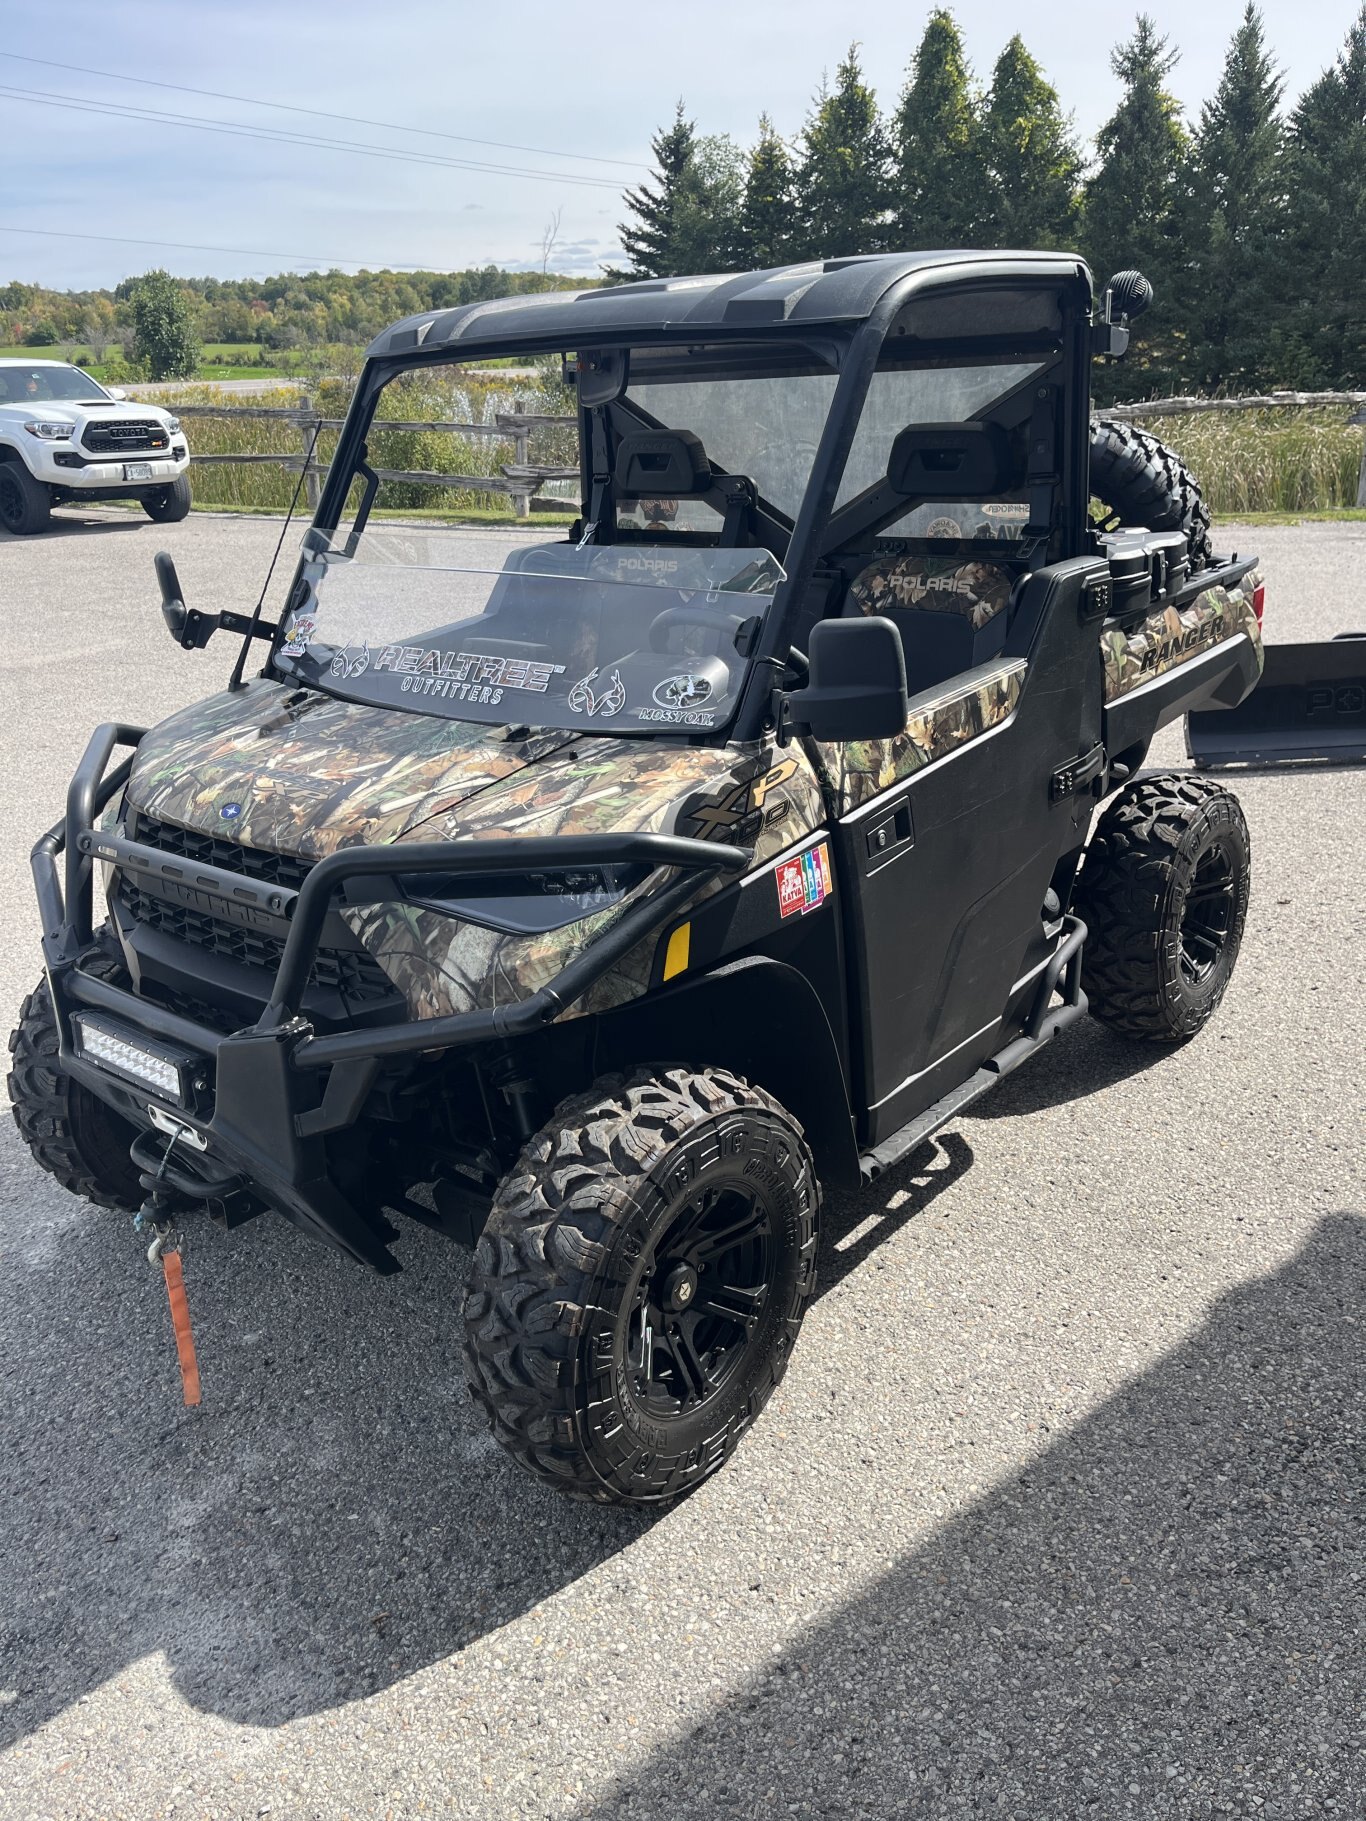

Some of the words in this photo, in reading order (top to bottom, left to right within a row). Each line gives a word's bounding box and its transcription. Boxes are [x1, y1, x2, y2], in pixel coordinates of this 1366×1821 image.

[112, 428, 147, 437] TOYOTA
[617, 557, 678, 573] POLARIS
[890, 575, 973, 595] POLARIS
[1140, 614, 1225, 675] RANGER
[373, 644, 556, 693] REALTREE
[400, 676, 504, 705] OUTFITTERS
[638, 707, 687, 723] MOSSY
[684, 711, 715, 726] OAK
[782, 887, 803, 904] KATVA
